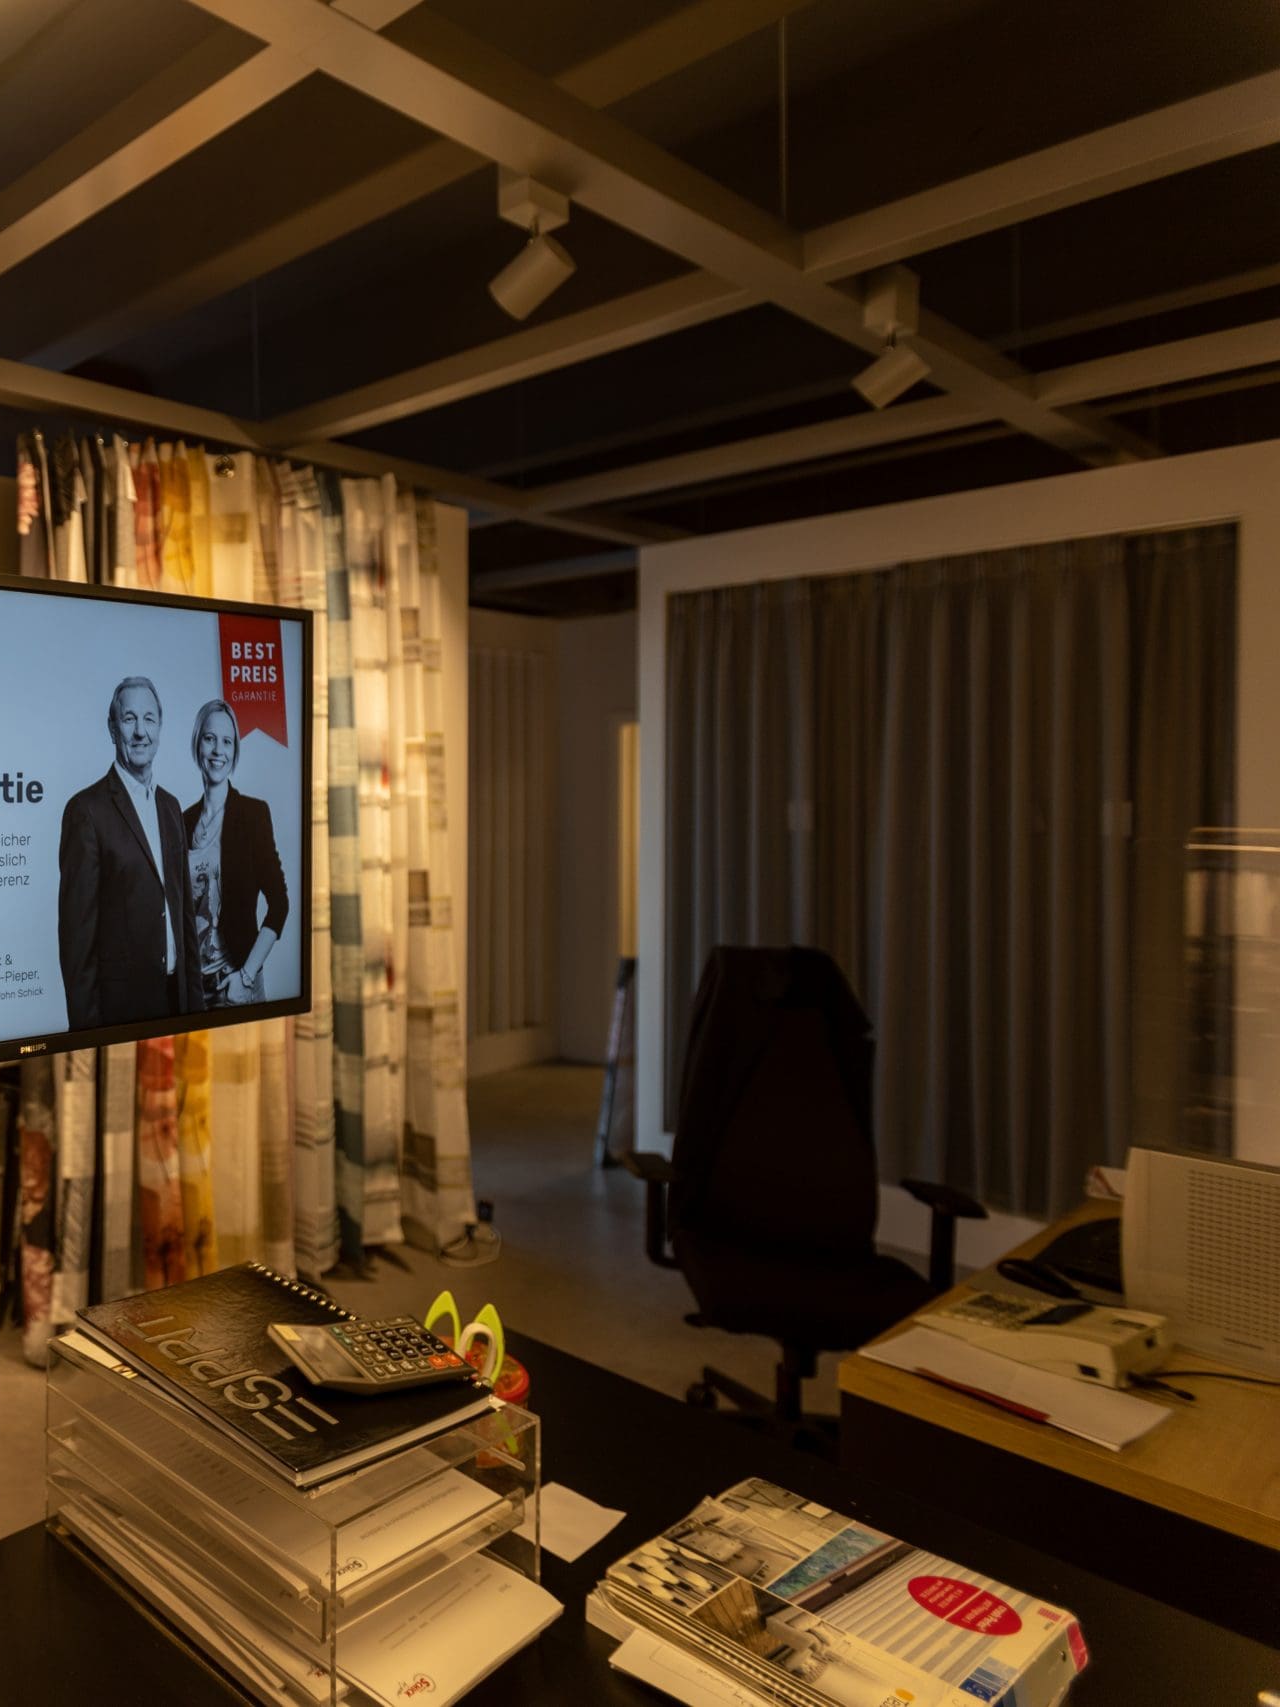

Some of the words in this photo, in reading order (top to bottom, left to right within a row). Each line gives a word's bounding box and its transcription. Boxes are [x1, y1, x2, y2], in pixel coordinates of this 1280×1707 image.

[231, 641, 275, 660] BEST
[231, 665, 277, 683] PREIS
[231, 690, 277, 702] GARANTIE
[4, 955, 13, 965] &
[17, 987, 44, 998] Schick
